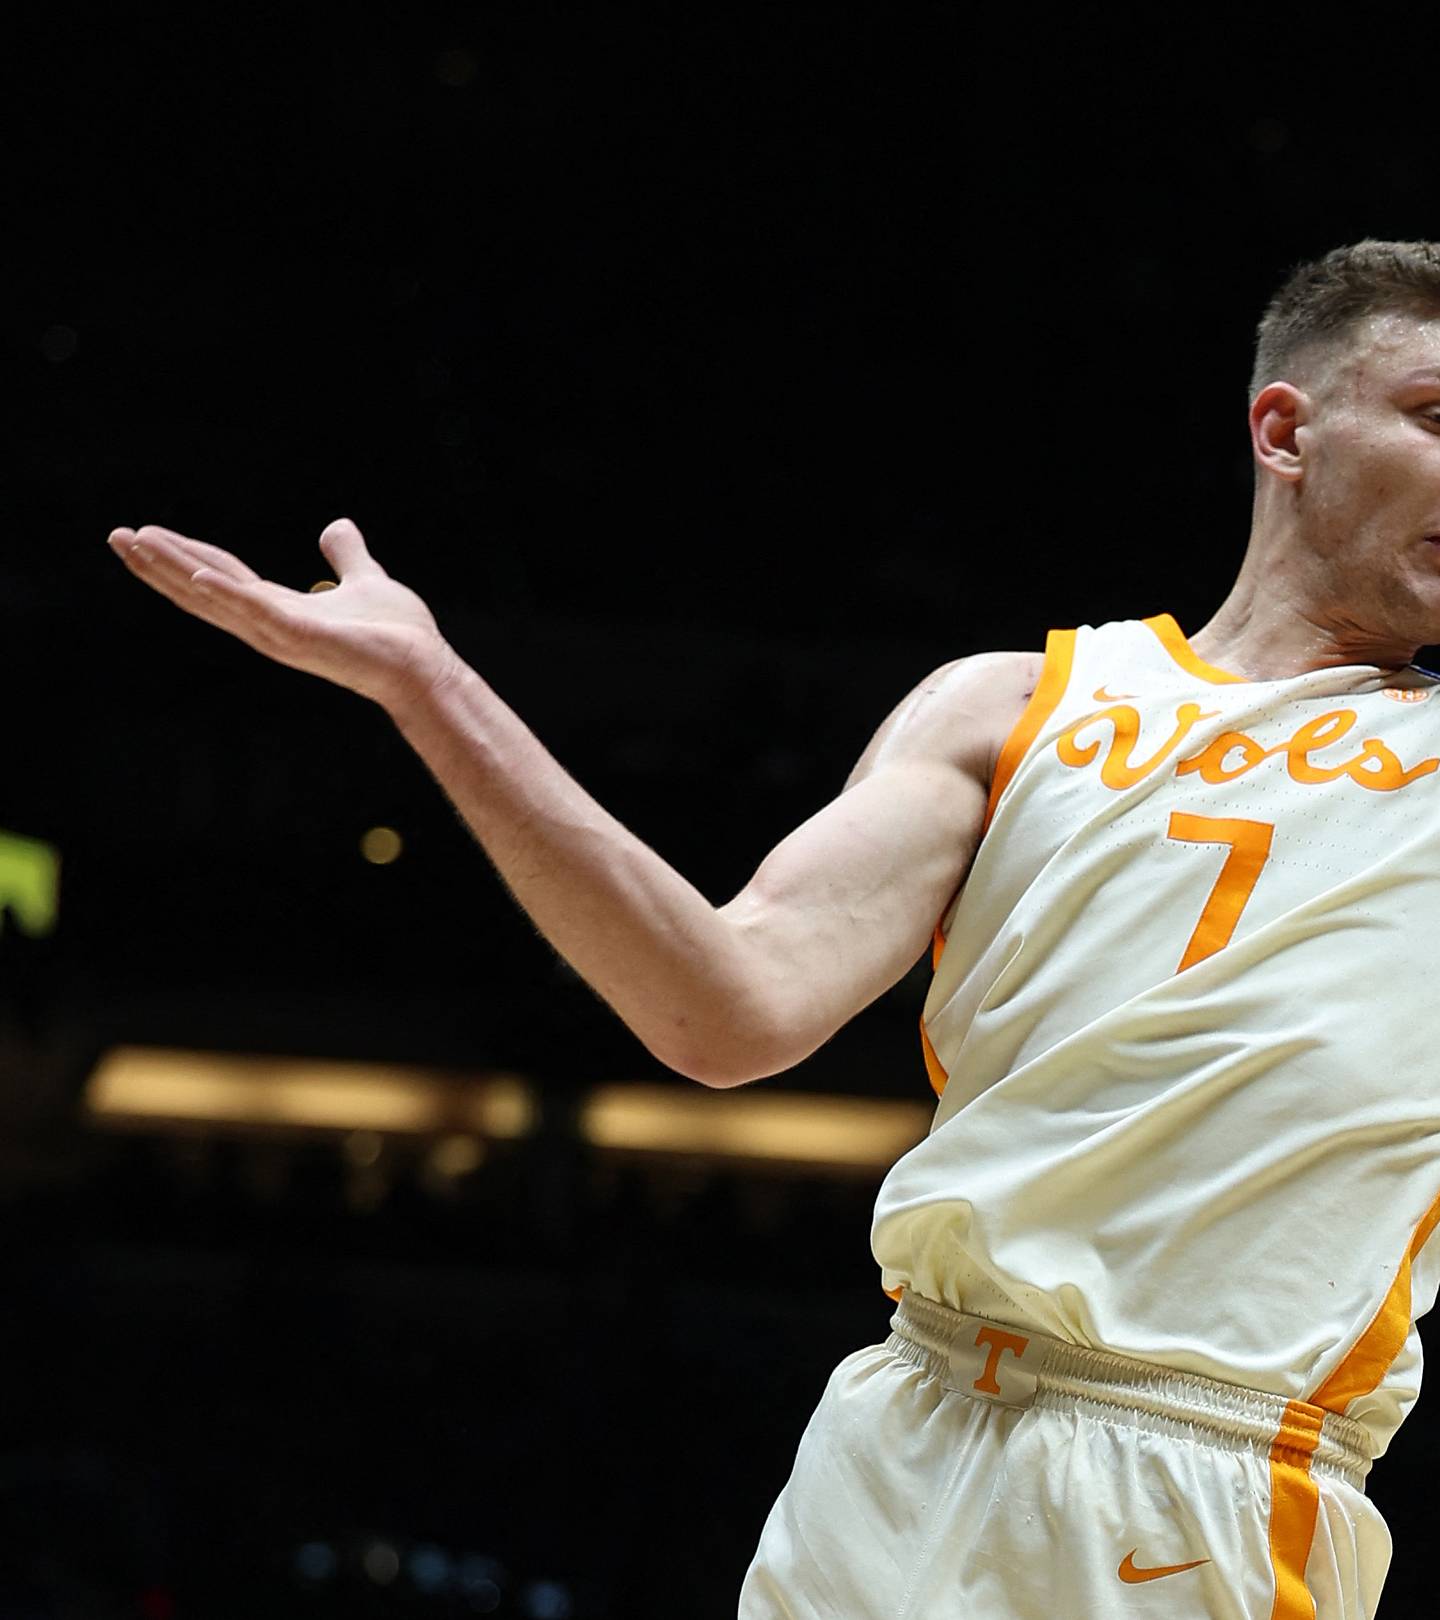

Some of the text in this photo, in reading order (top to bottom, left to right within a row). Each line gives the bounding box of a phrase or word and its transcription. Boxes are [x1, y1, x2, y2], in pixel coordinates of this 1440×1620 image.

[1056, 703, 1440, 792] Vols
[1166, 811, 1276, 976] 7
[973, 1325, 1031, 1395] T
